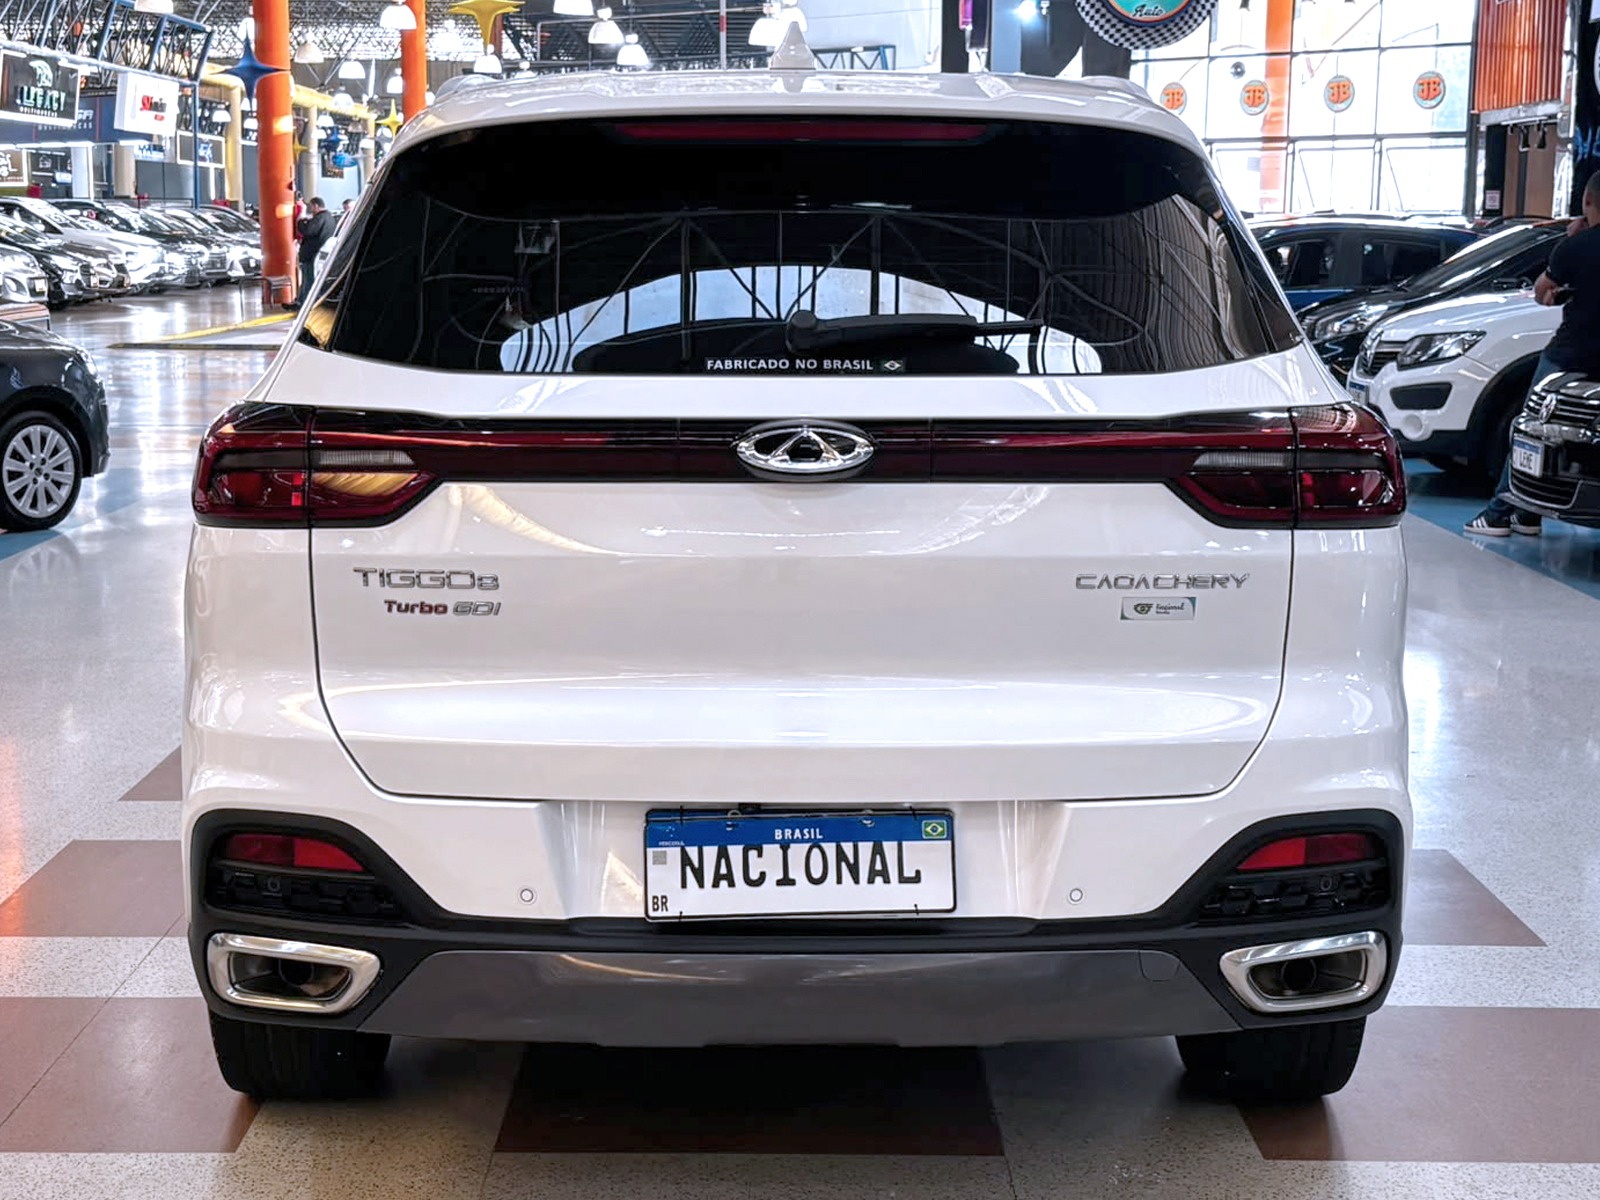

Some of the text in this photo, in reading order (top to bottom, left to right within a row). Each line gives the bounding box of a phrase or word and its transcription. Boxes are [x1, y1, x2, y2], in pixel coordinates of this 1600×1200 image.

[1132, 4, 1164, 17] Auto
[707, 359, 873, 370] FABRICADO NO BRASIL
[384, 599, 501, 616] Turbo GDI
[774, 827, 823, 840] BRASIL
[680, 841, 922, 889] NACIONAL
[651, 895, 669, 912] BR
